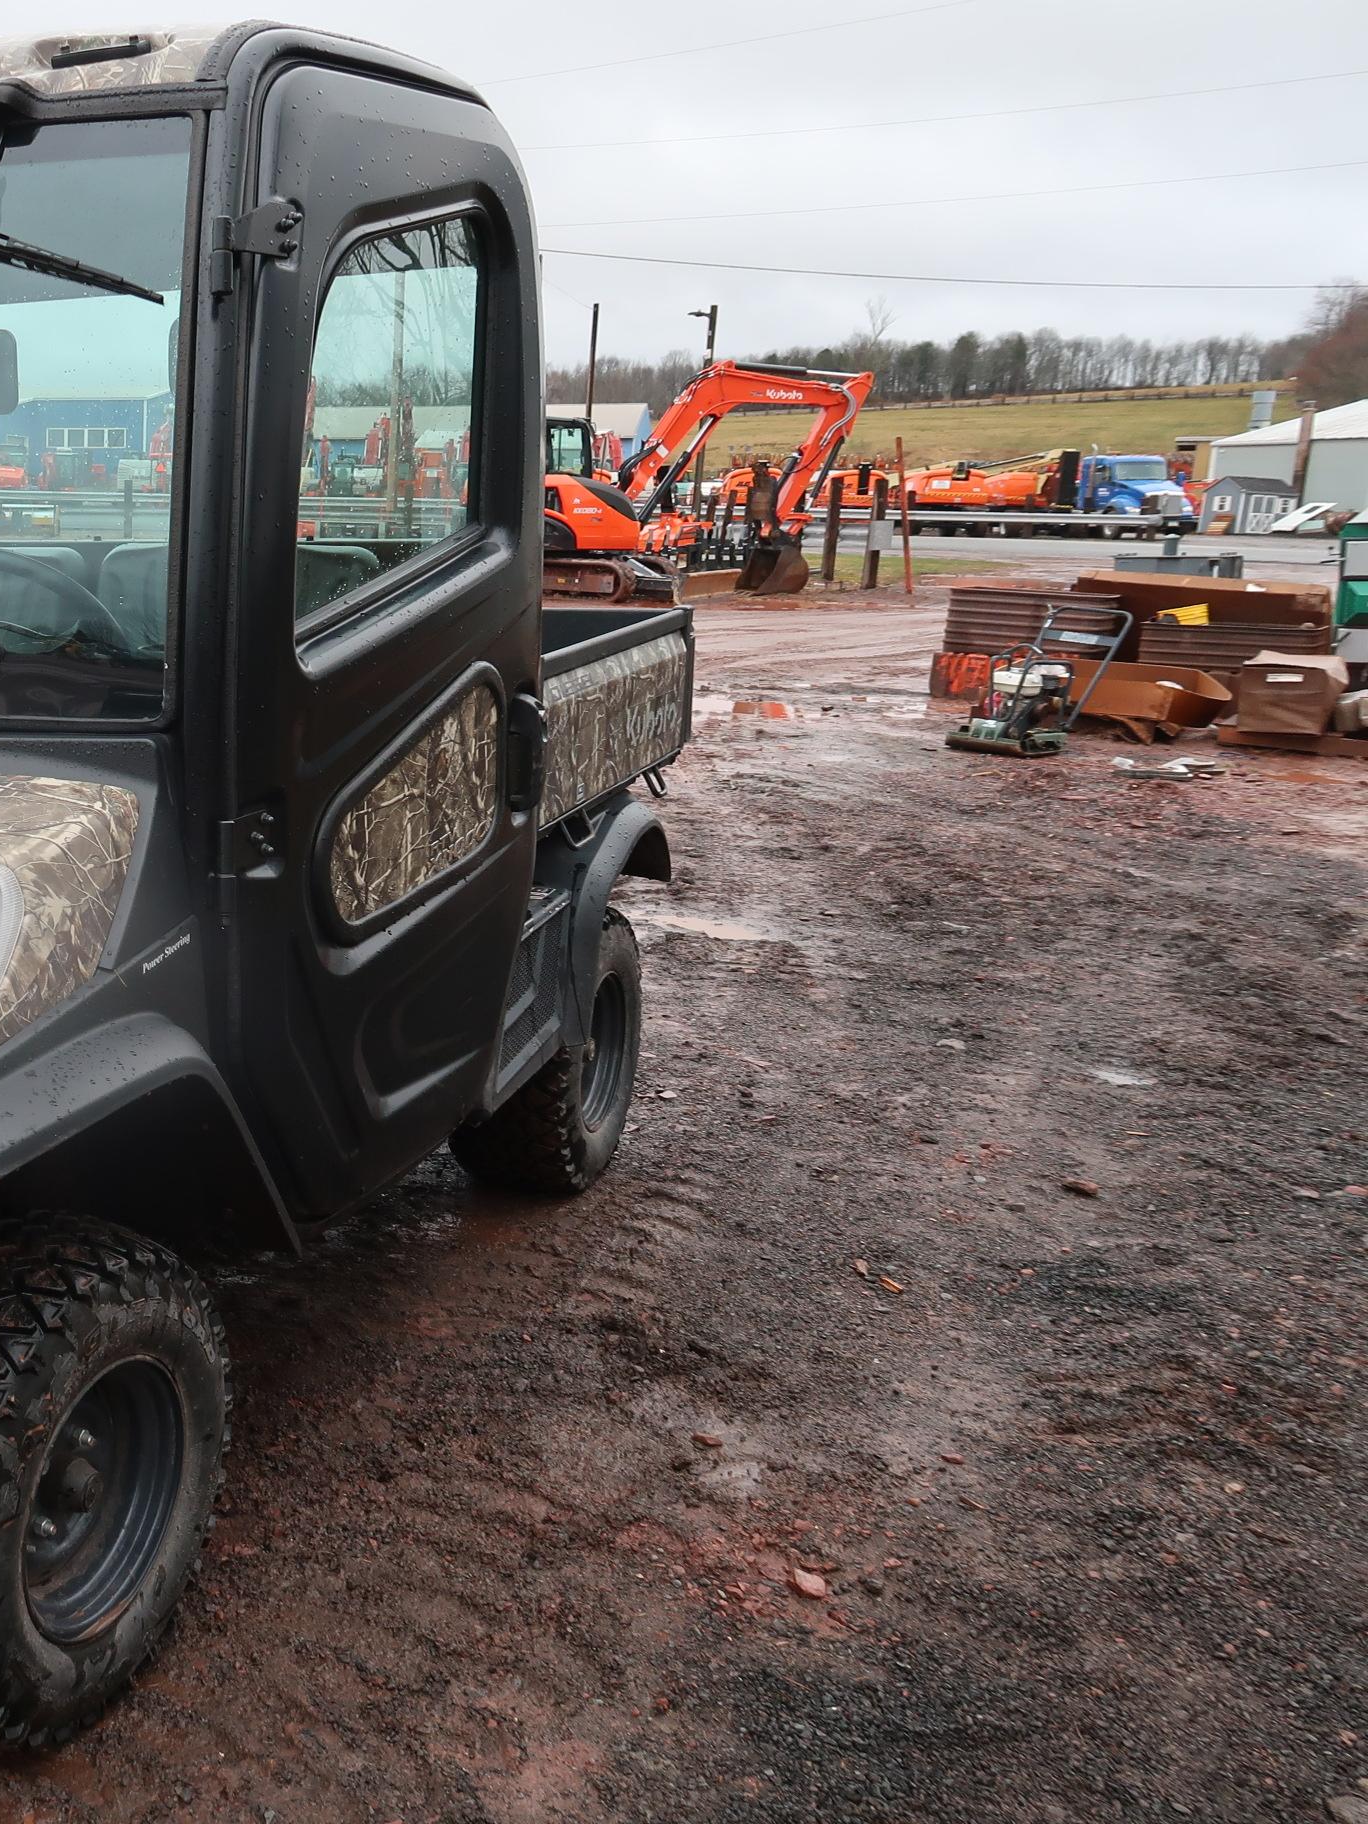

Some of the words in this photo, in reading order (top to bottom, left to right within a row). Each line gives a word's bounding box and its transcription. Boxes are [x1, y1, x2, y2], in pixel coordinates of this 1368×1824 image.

[766, 388, 803, 400] Kubota
[625, 694, 677, 746] Kubota
[142, 952, 164, 974] Power
[164, 932, 191, 958] Steering
